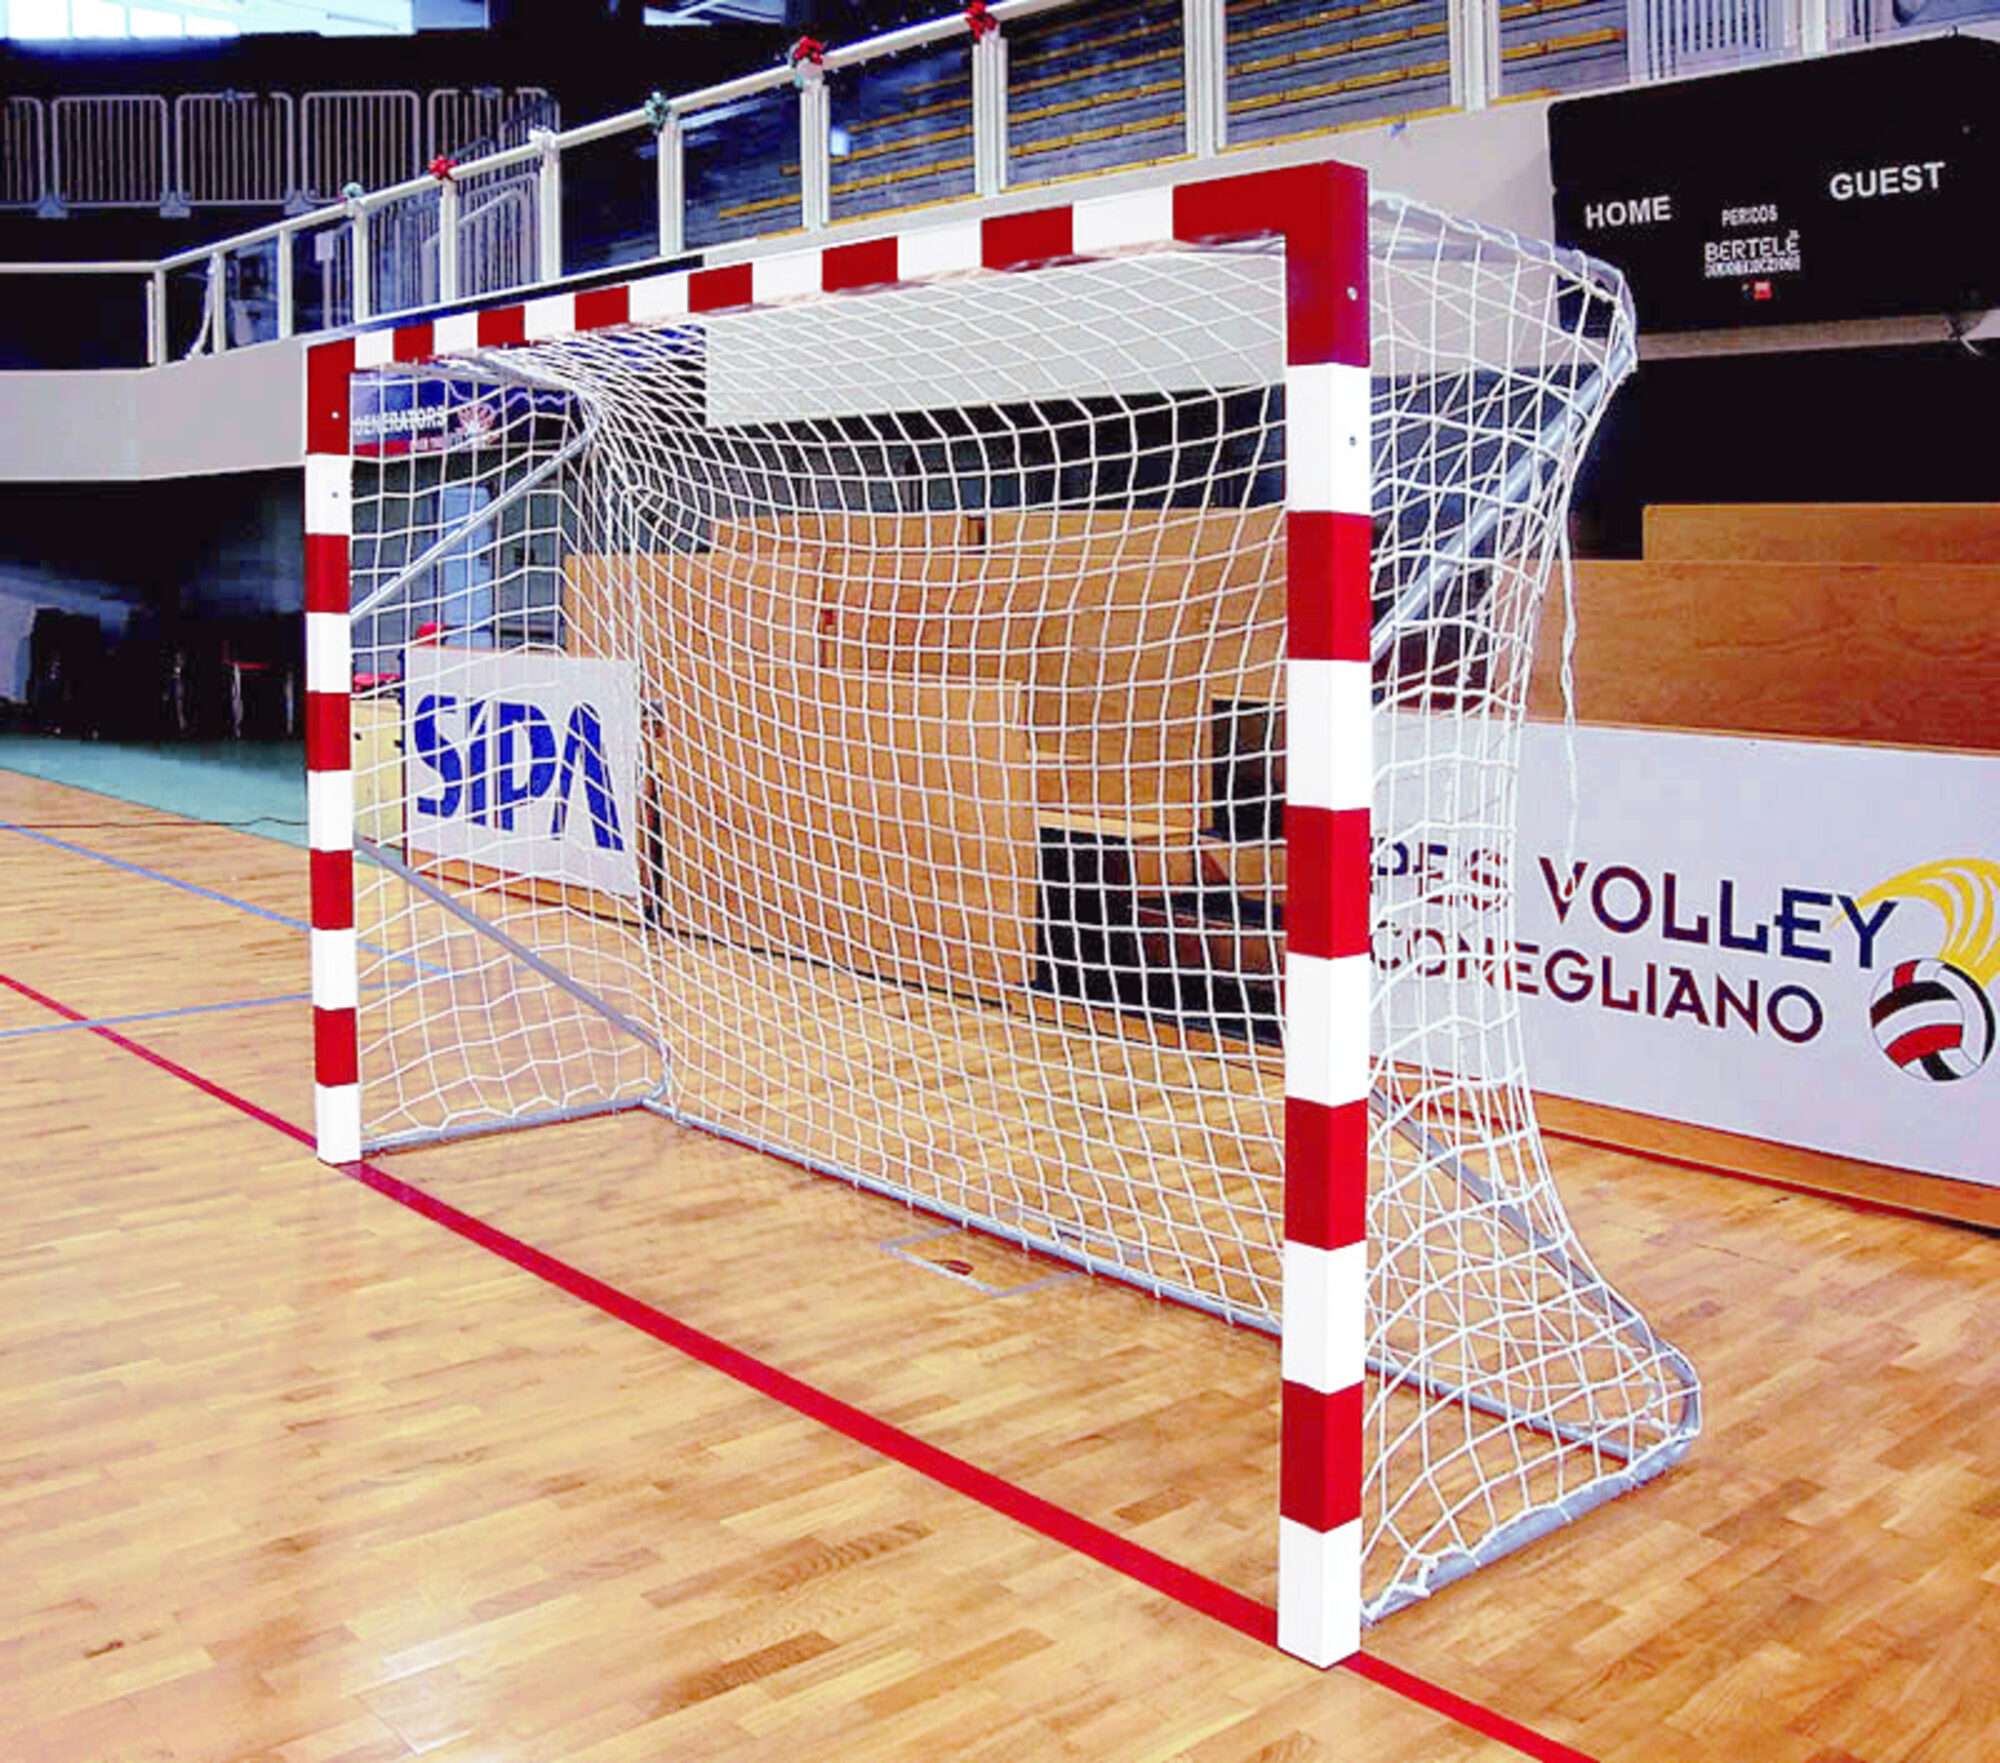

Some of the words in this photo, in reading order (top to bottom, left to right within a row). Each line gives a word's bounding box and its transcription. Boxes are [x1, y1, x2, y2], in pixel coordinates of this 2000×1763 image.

[1584, 194, 1672, 229] HOME
[1829, 161, 1946, 201] GUEST
[414, 694, 625, 852] SIPA
[1538, 856, 1899, 969] VOLLEY
[1370, 919, 1823, 1043] CONEGLIANO
